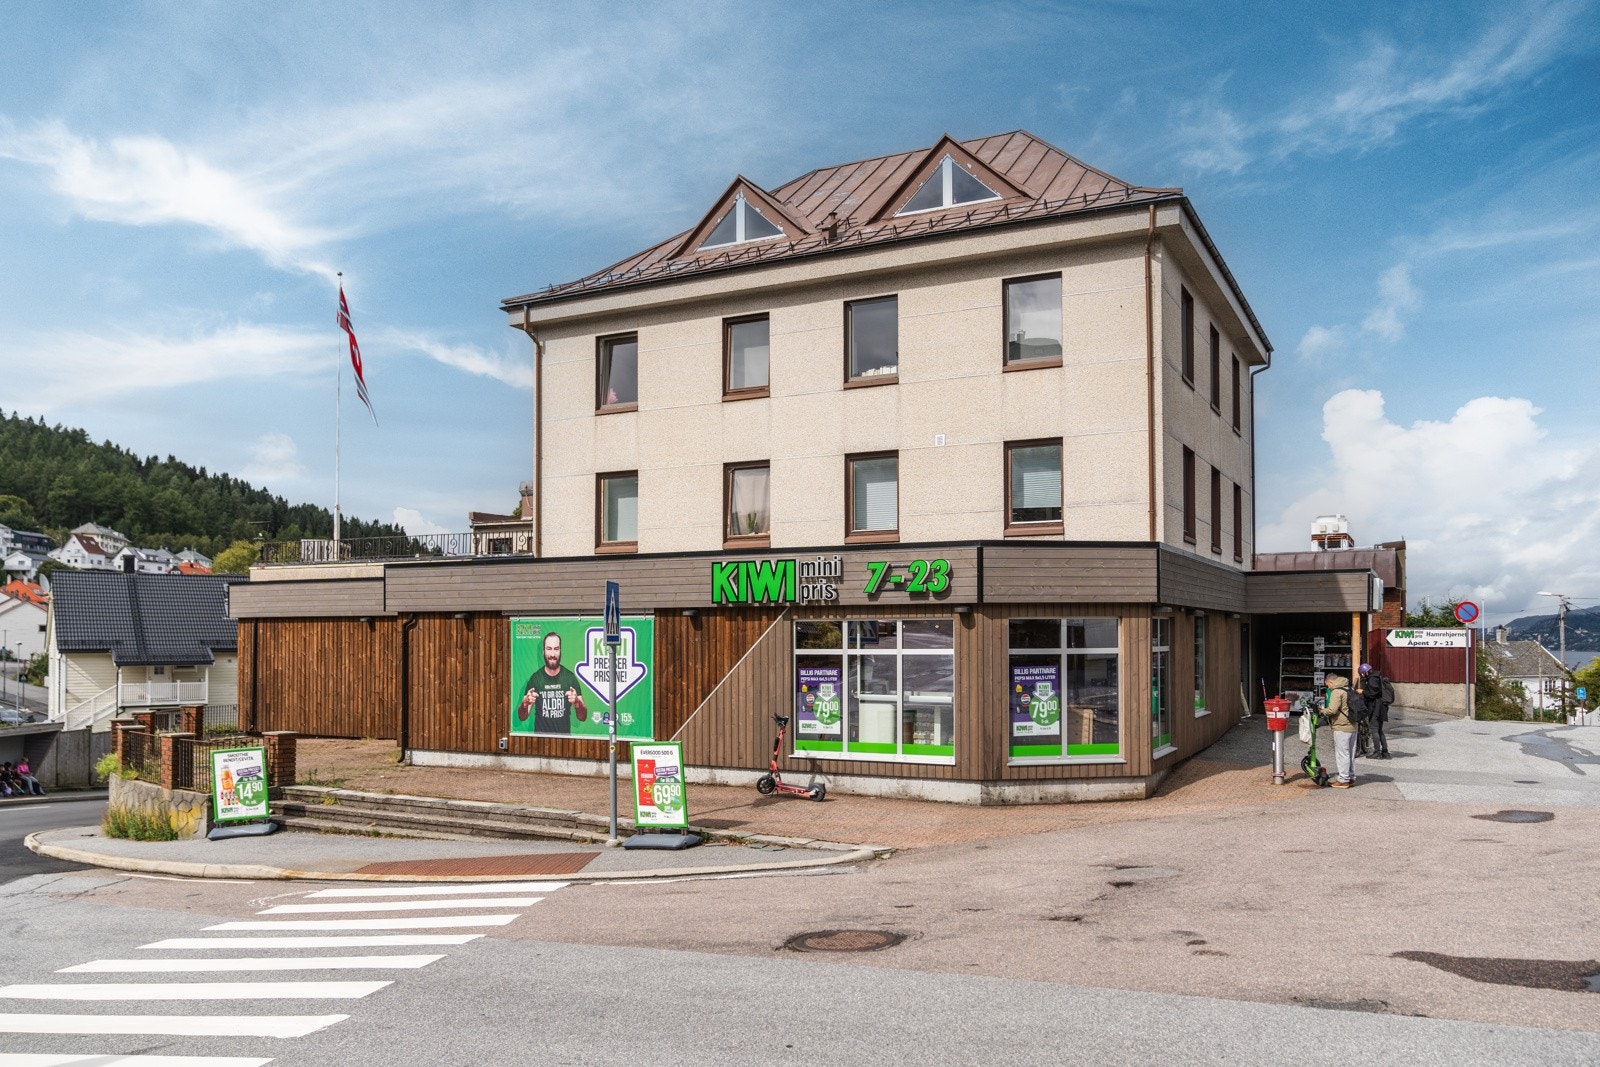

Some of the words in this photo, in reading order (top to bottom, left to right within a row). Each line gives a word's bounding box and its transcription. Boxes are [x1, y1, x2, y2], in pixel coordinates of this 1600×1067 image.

[800, 556, 841, 577] mini
[711, 559, 798, 605] KIWI
[800, 579, 838, 604] pris
[594, 671, 627, 682] PRISNE!
